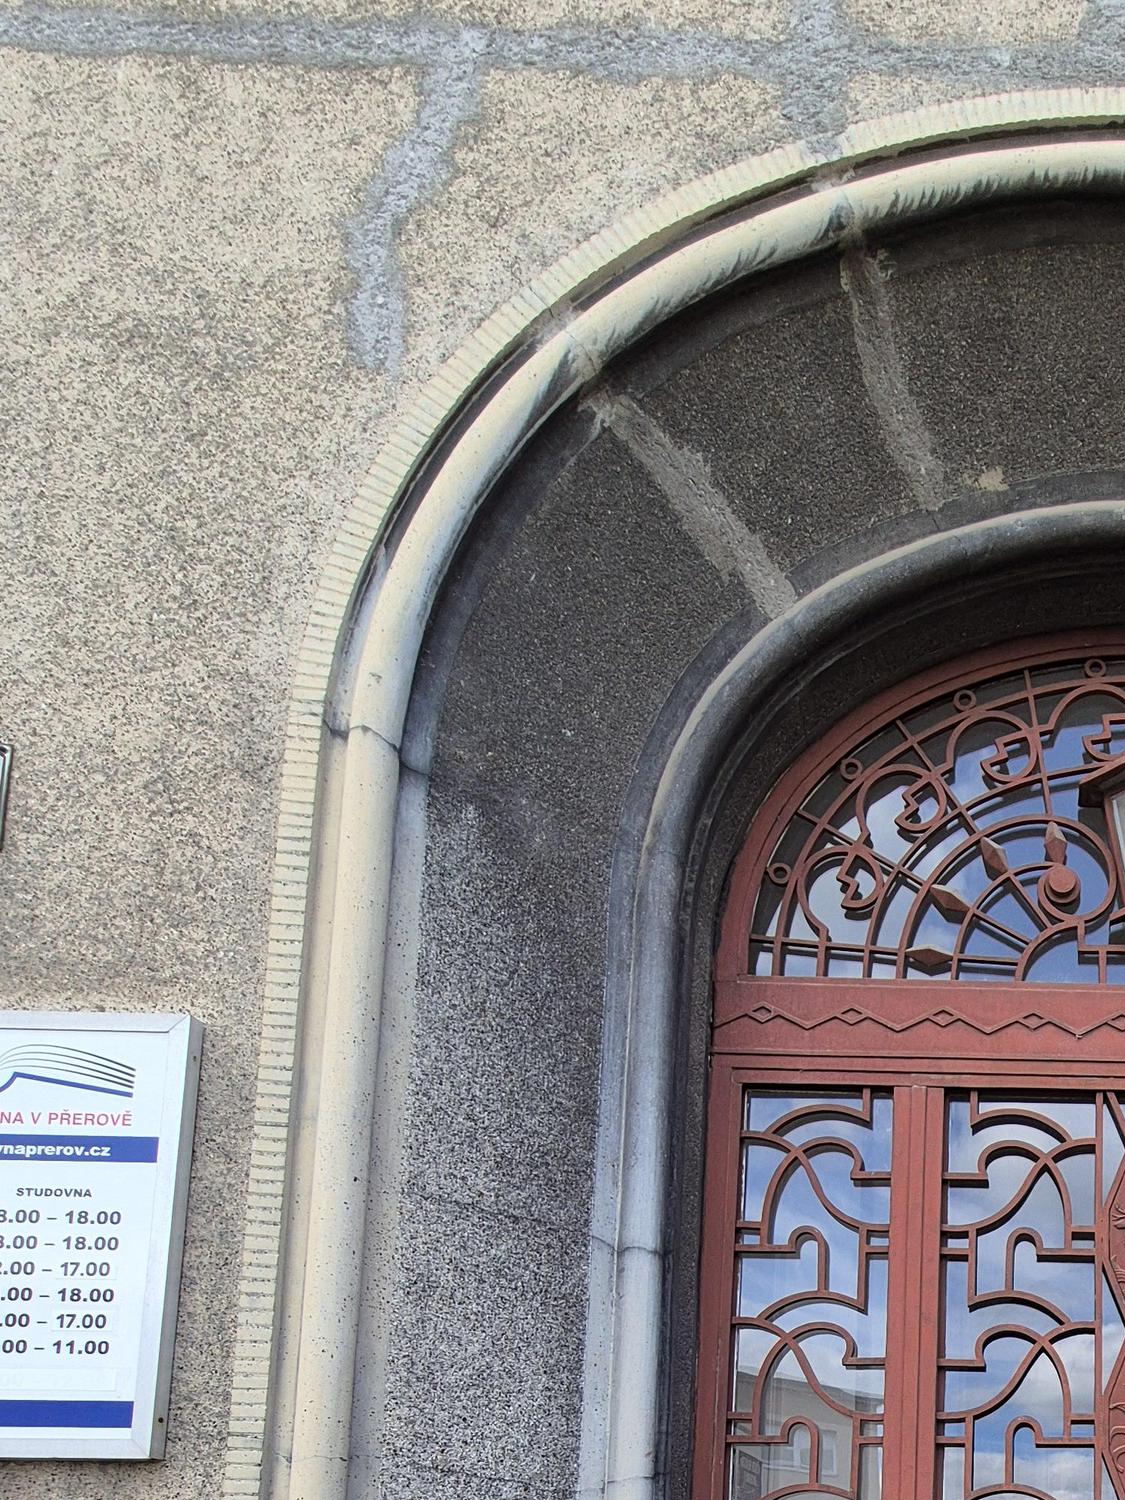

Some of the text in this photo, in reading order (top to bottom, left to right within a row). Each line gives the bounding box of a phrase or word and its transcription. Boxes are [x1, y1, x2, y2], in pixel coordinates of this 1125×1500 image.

[31, 1111, 42, 1125] V
[48, 1109, 132, 1126] PŘEROVĚ
[16, 1187, 92, 1198] STUDOVNA
[65, 1210, 121, 1225] 18.00
[62, 1236, 119, 1251] 18.00
[60, 1262, 111, 1276] 17.00
[57, 1288, 115, 1302] 18.00
[56, 1314, 107, 1329] 17.00
[53, 1340, 110, 1355] 11.00
